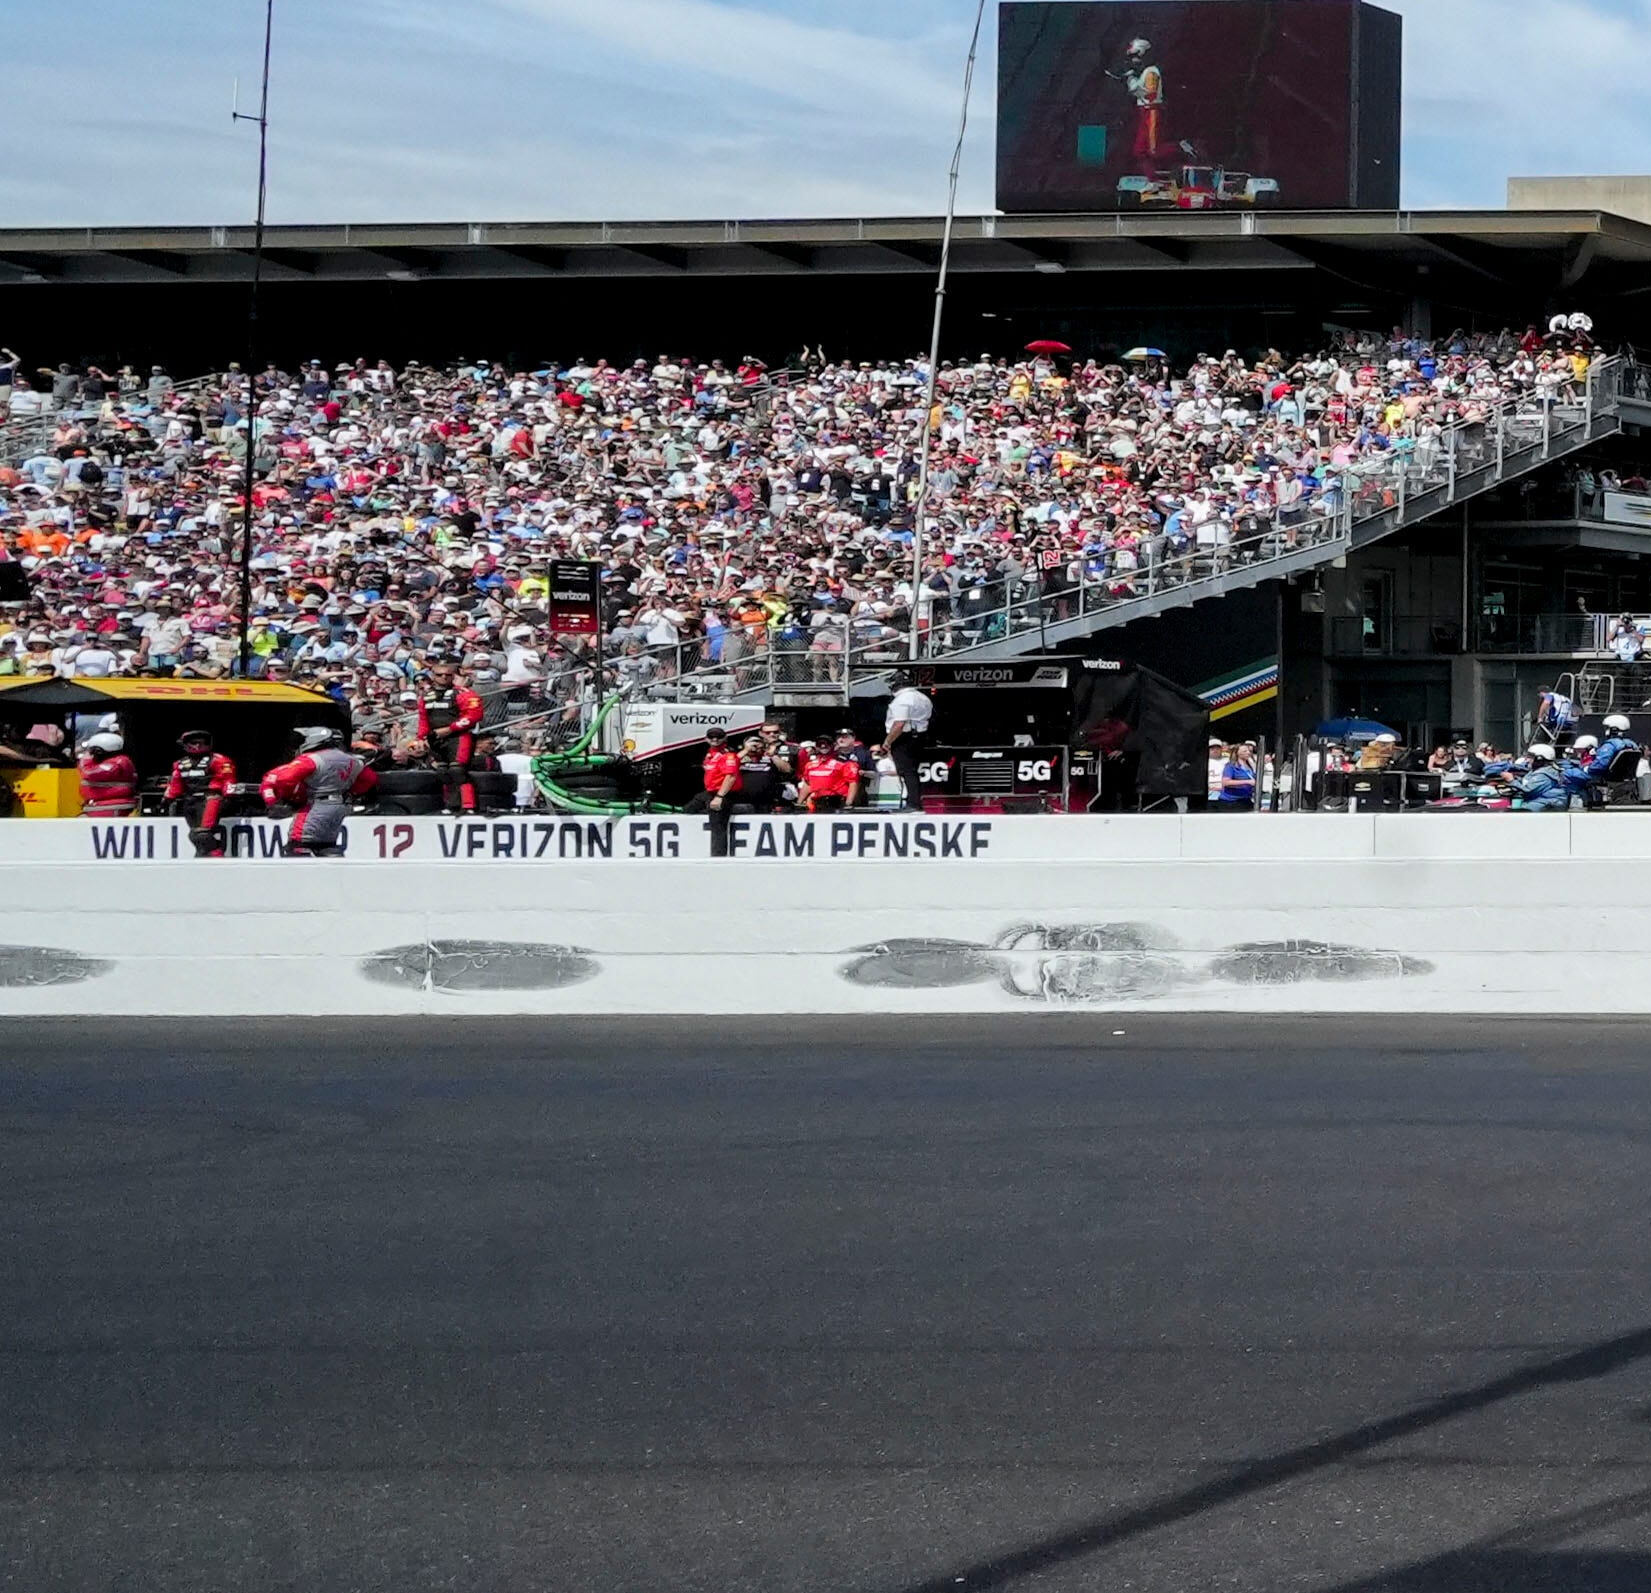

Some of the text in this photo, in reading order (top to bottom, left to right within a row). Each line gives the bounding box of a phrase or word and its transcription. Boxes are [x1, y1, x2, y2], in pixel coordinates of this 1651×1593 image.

[552, 590, 590, 601] verizon
[1082, 659, 1121, 670] verizon
[954, 666, 1014, 682] verizon
[144, 686, 273, 696] DHL
[669, 711, 729, 725] verizon
[918, 761, 949, 783] 5G
[1018, 760, 1051, 781] 5G
[1070, 766, 1085, 776] 5G
[374, 824, 415, 858] 12
[630, 824, 680, 858] 5G
[831, 822, 992, 858] PENSKE
